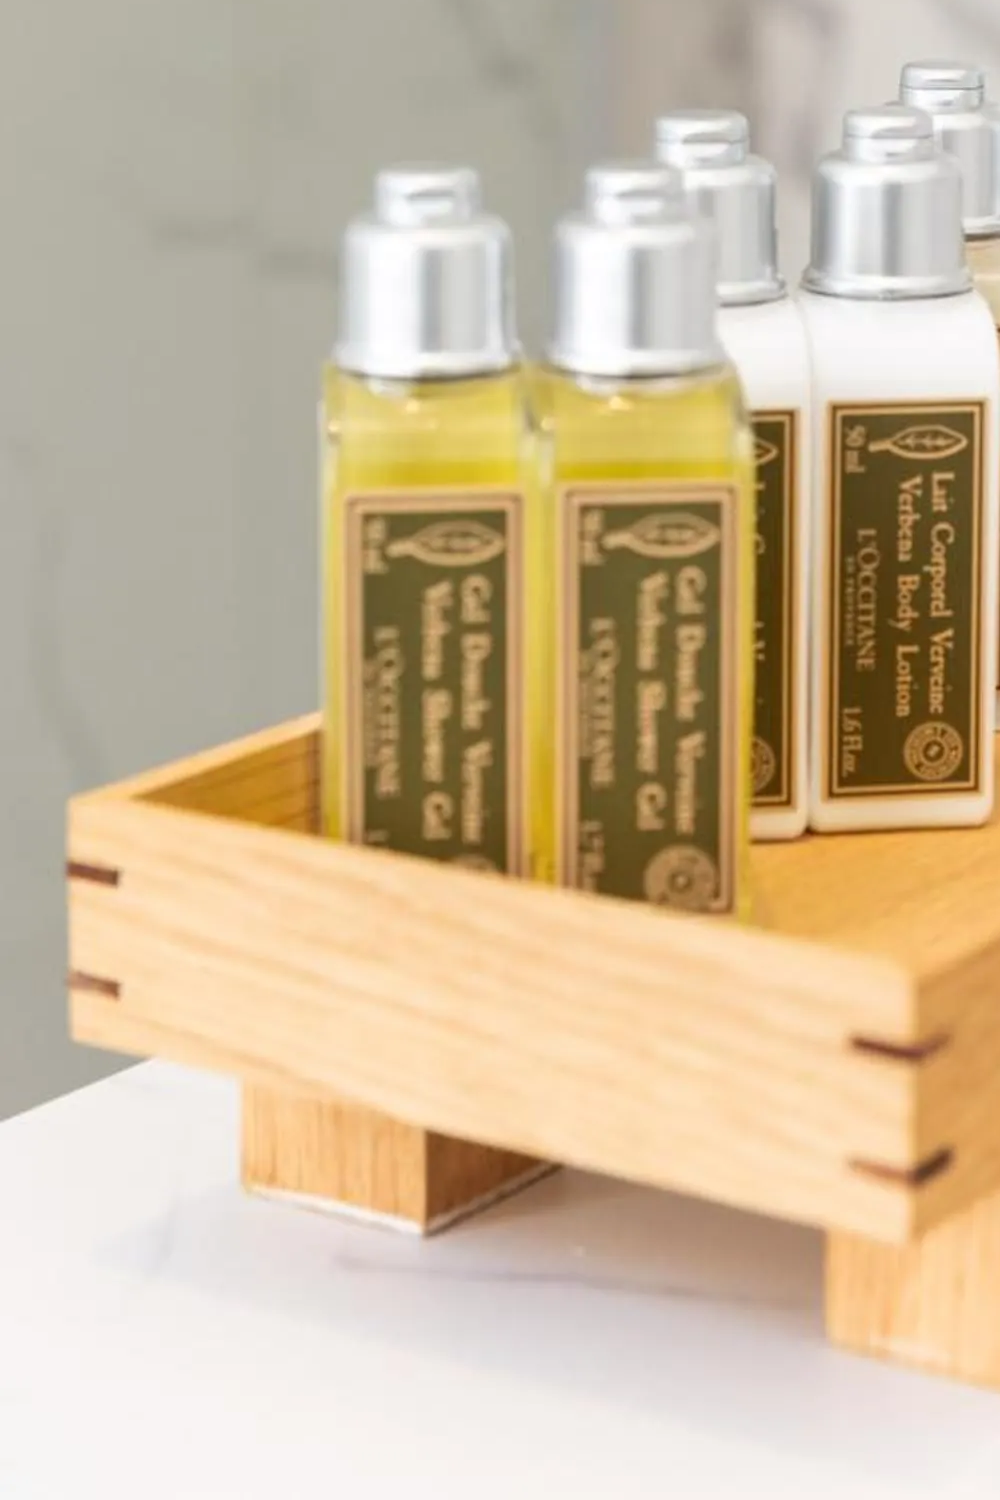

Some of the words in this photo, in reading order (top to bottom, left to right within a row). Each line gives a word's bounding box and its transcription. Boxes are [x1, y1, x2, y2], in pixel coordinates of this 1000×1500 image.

[844, 423, 866, 447] 50
[844, 451, 865, 475] ml
[896, 474, 923, 563] Verbena
[931, 471, 955, 513] Lait
[855, 528, 880, 673] L'OCCITANE
[887, 573, 920, 632] Body
[922, 520, 955, 619] Corporel
[895, 644, 919, 718] Lotion
[929, 628, 954, 715] Verveine
